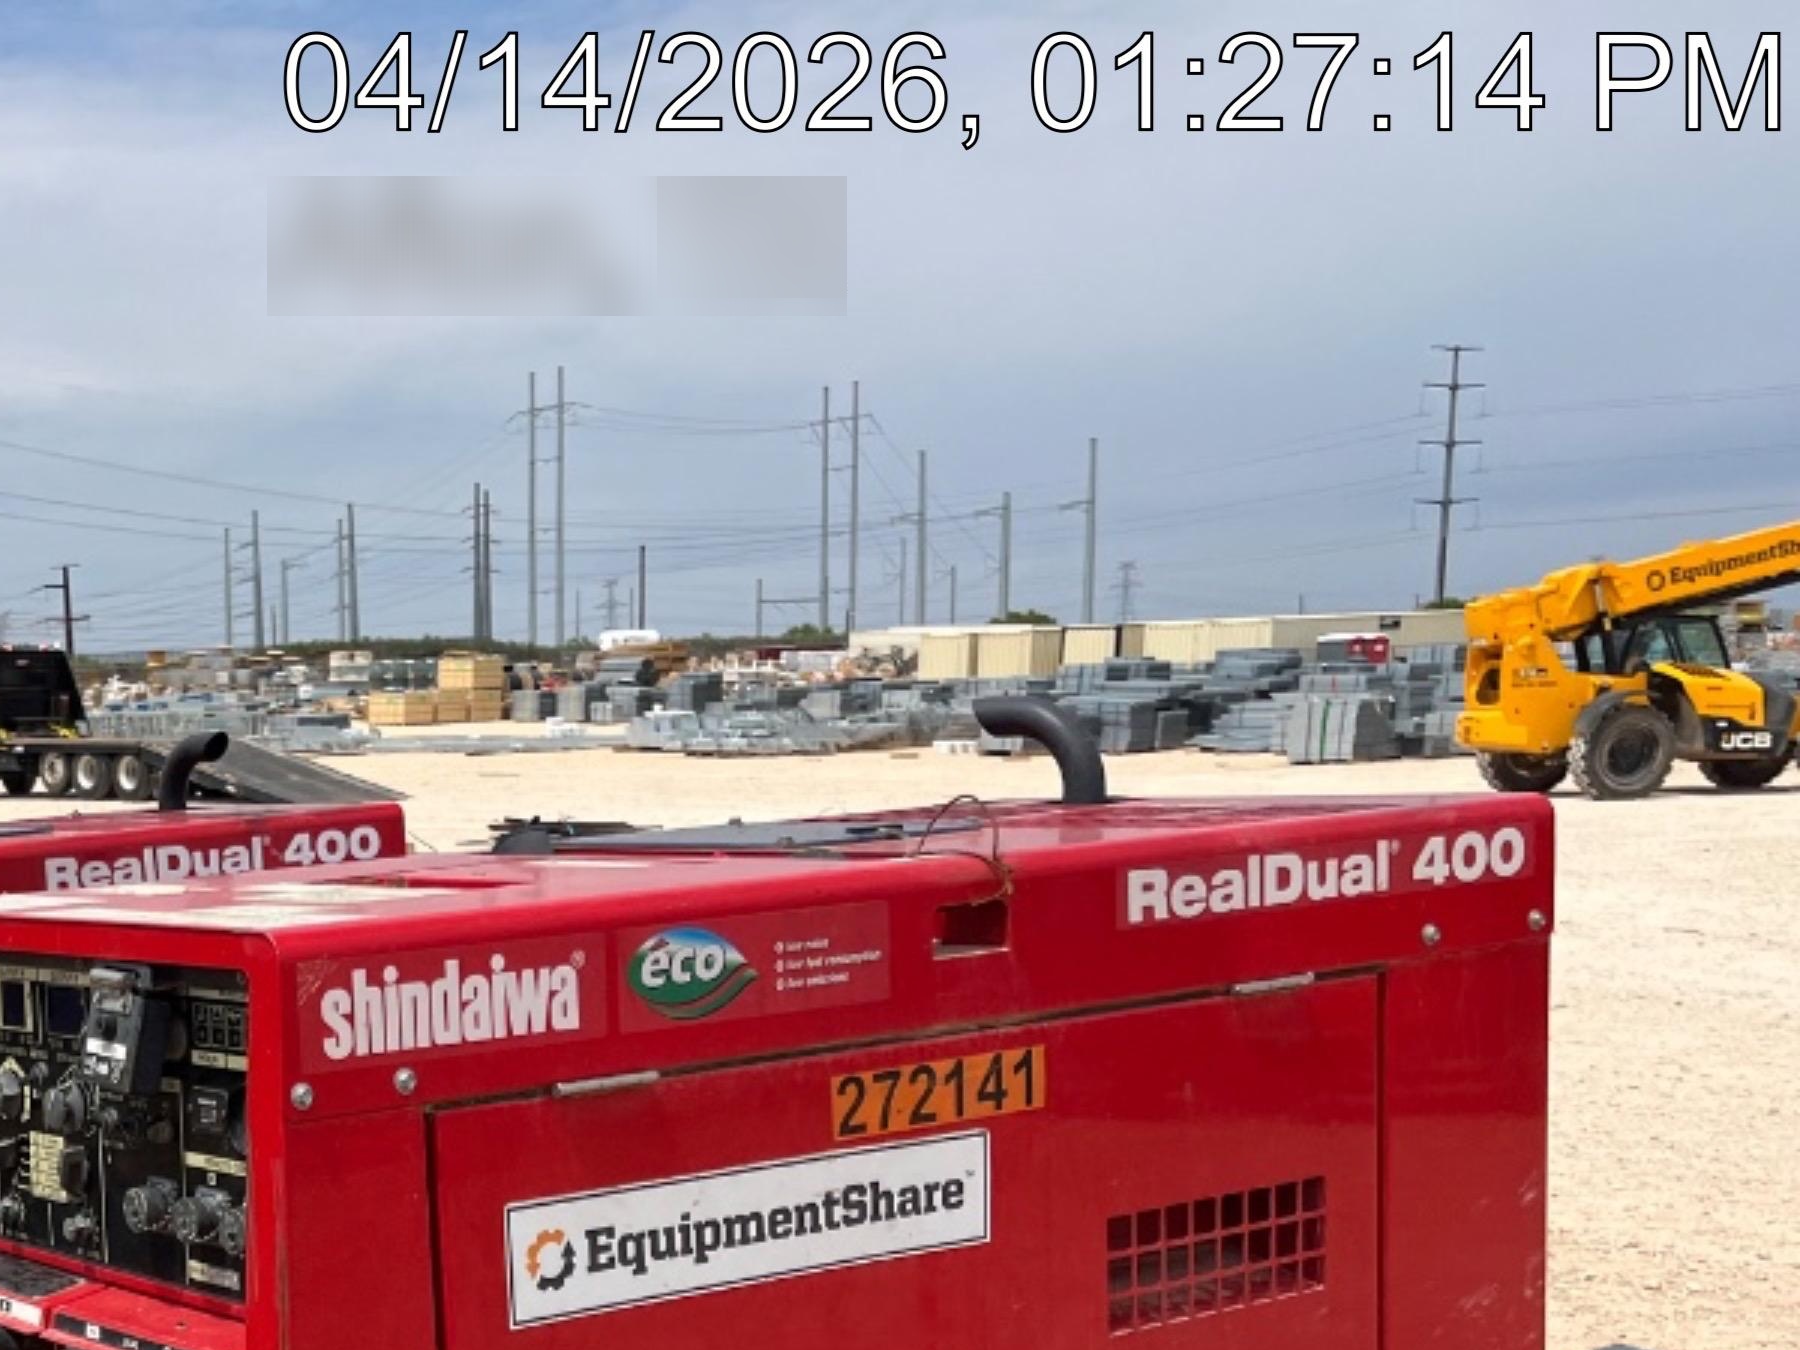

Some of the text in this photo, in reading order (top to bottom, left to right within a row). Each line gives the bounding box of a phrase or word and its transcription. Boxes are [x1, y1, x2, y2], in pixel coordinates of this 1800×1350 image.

[1721, 731, 1772, 750] JCB
[45, 825, 381, 891] RealDual 400
[1126, 826, 1526, 924] RealDual 400
[320, 953, 580, 1061] shindaiwa
[837, 1048, 1036, 1137] 272141
[585, 1177, 966, 1275] EquipmentShare
